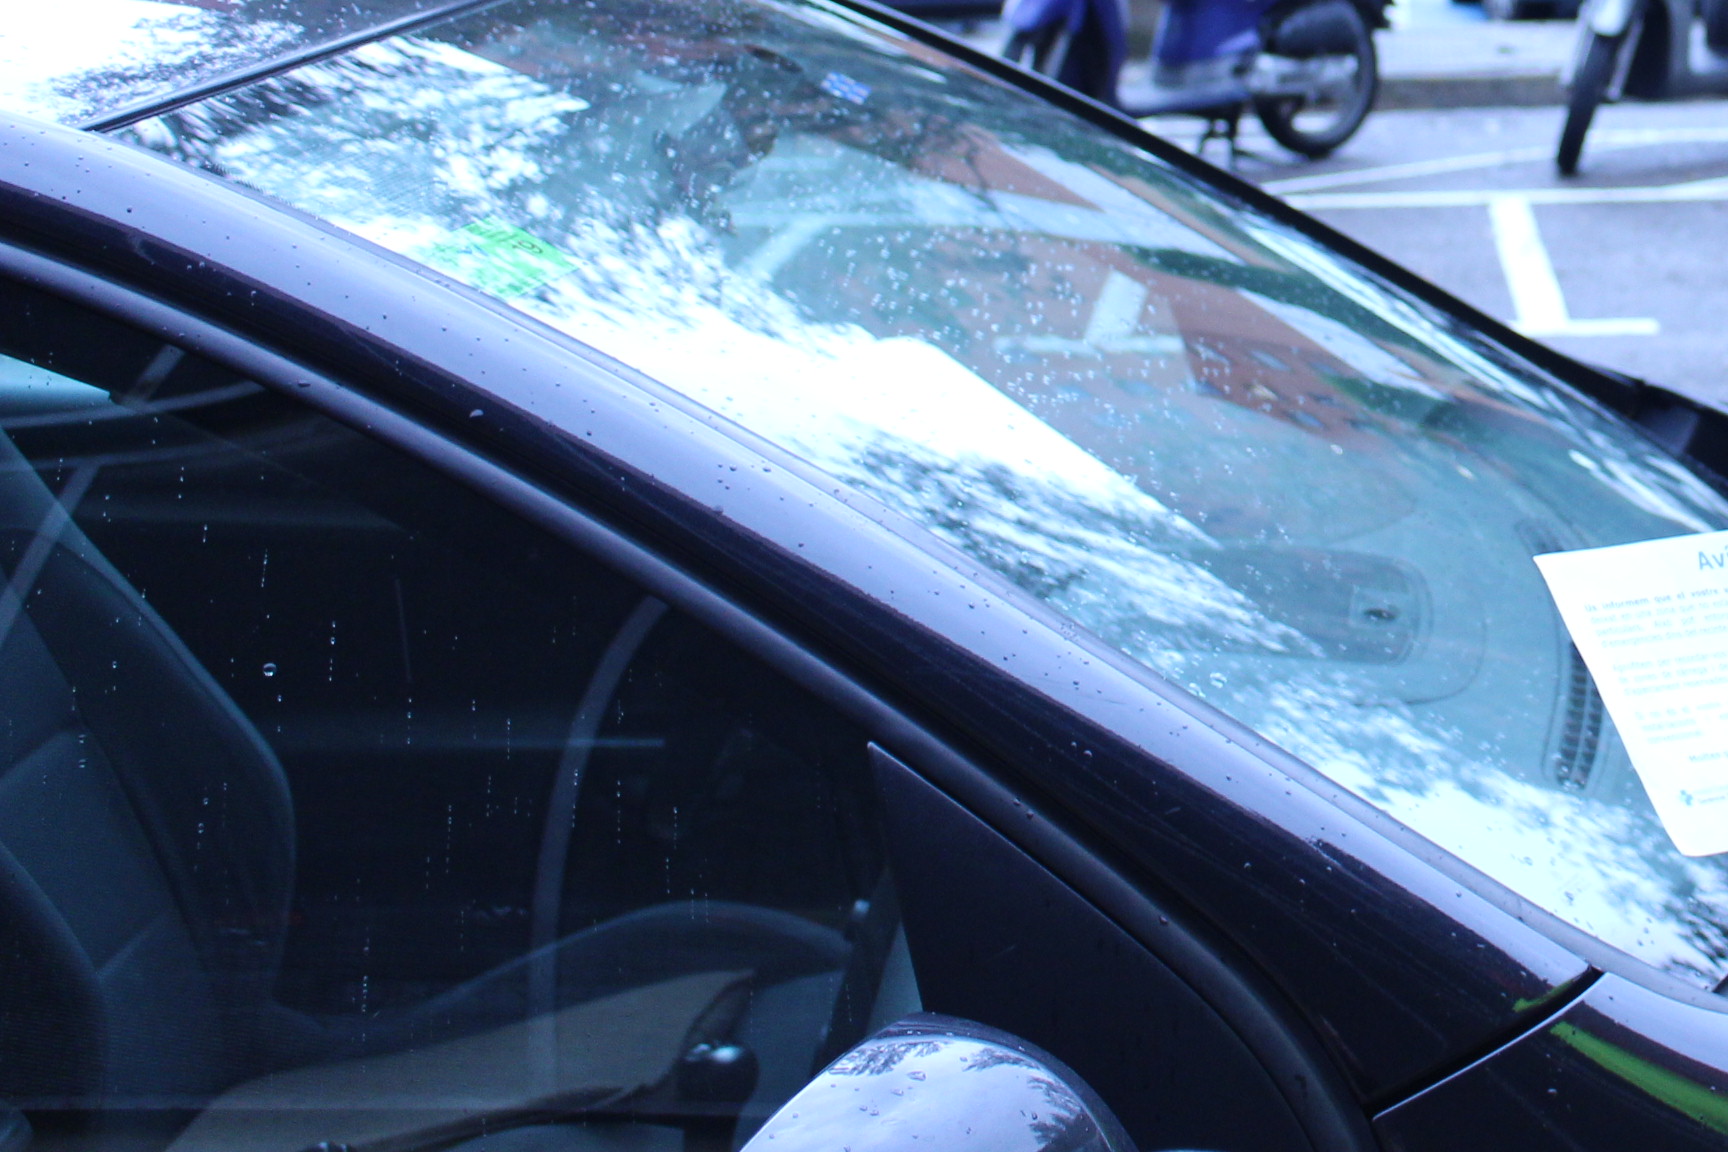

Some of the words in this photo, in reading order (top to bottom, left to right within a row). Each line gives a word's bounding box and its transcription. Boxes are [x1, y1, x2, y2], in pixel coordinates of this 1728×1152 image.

[1602, 597, 1650, 609] informem
[1654, 594, 1672, 604] que
[1676, 591, 1685, 600] el
[1690, 588, 1719, 598] vostre
